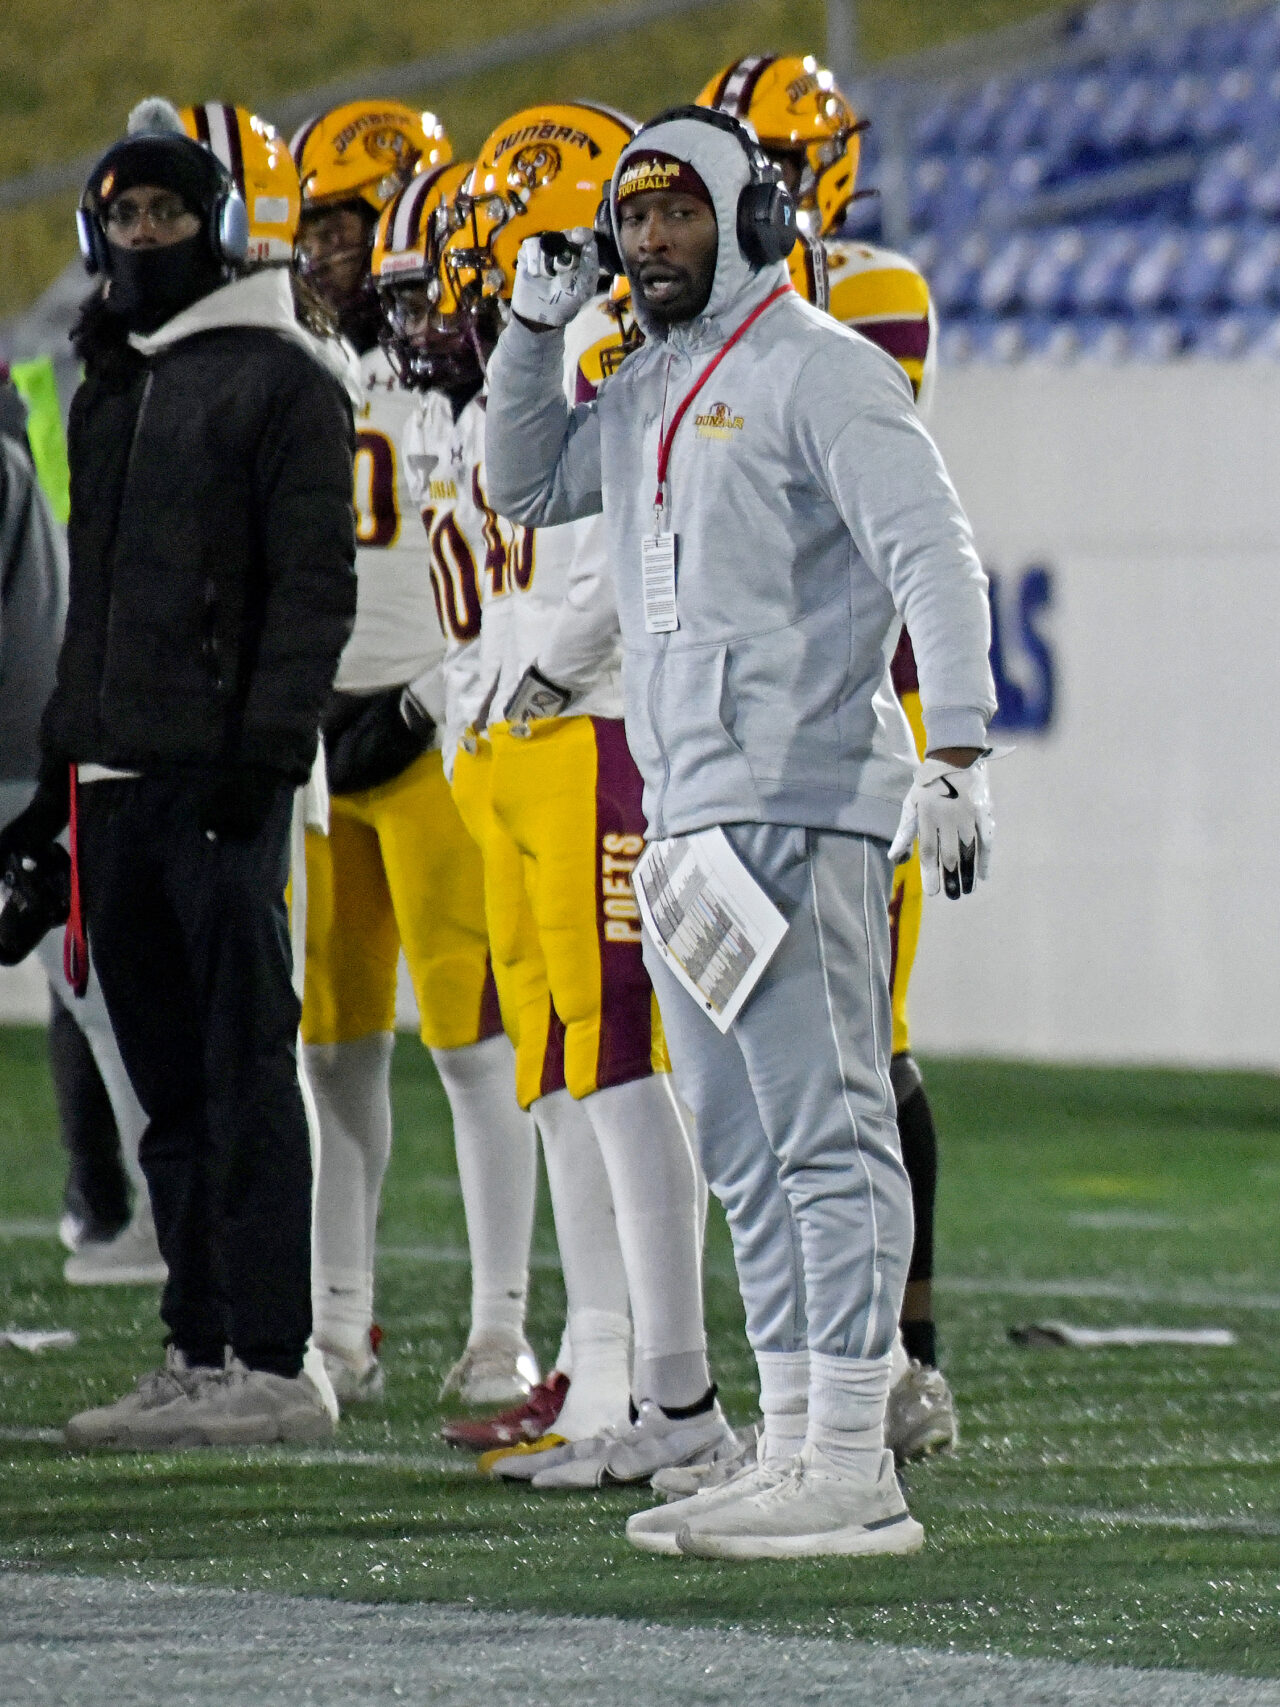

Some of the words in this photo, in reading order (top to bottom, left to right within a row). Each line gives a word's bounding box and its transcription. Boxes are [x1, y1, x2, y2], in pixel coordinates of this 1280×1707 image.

[494, 123, 590, 160] DUNBAR
[617, 176, 670, 200] FOOTBALL
[602, 833, 645, 942] POETS
